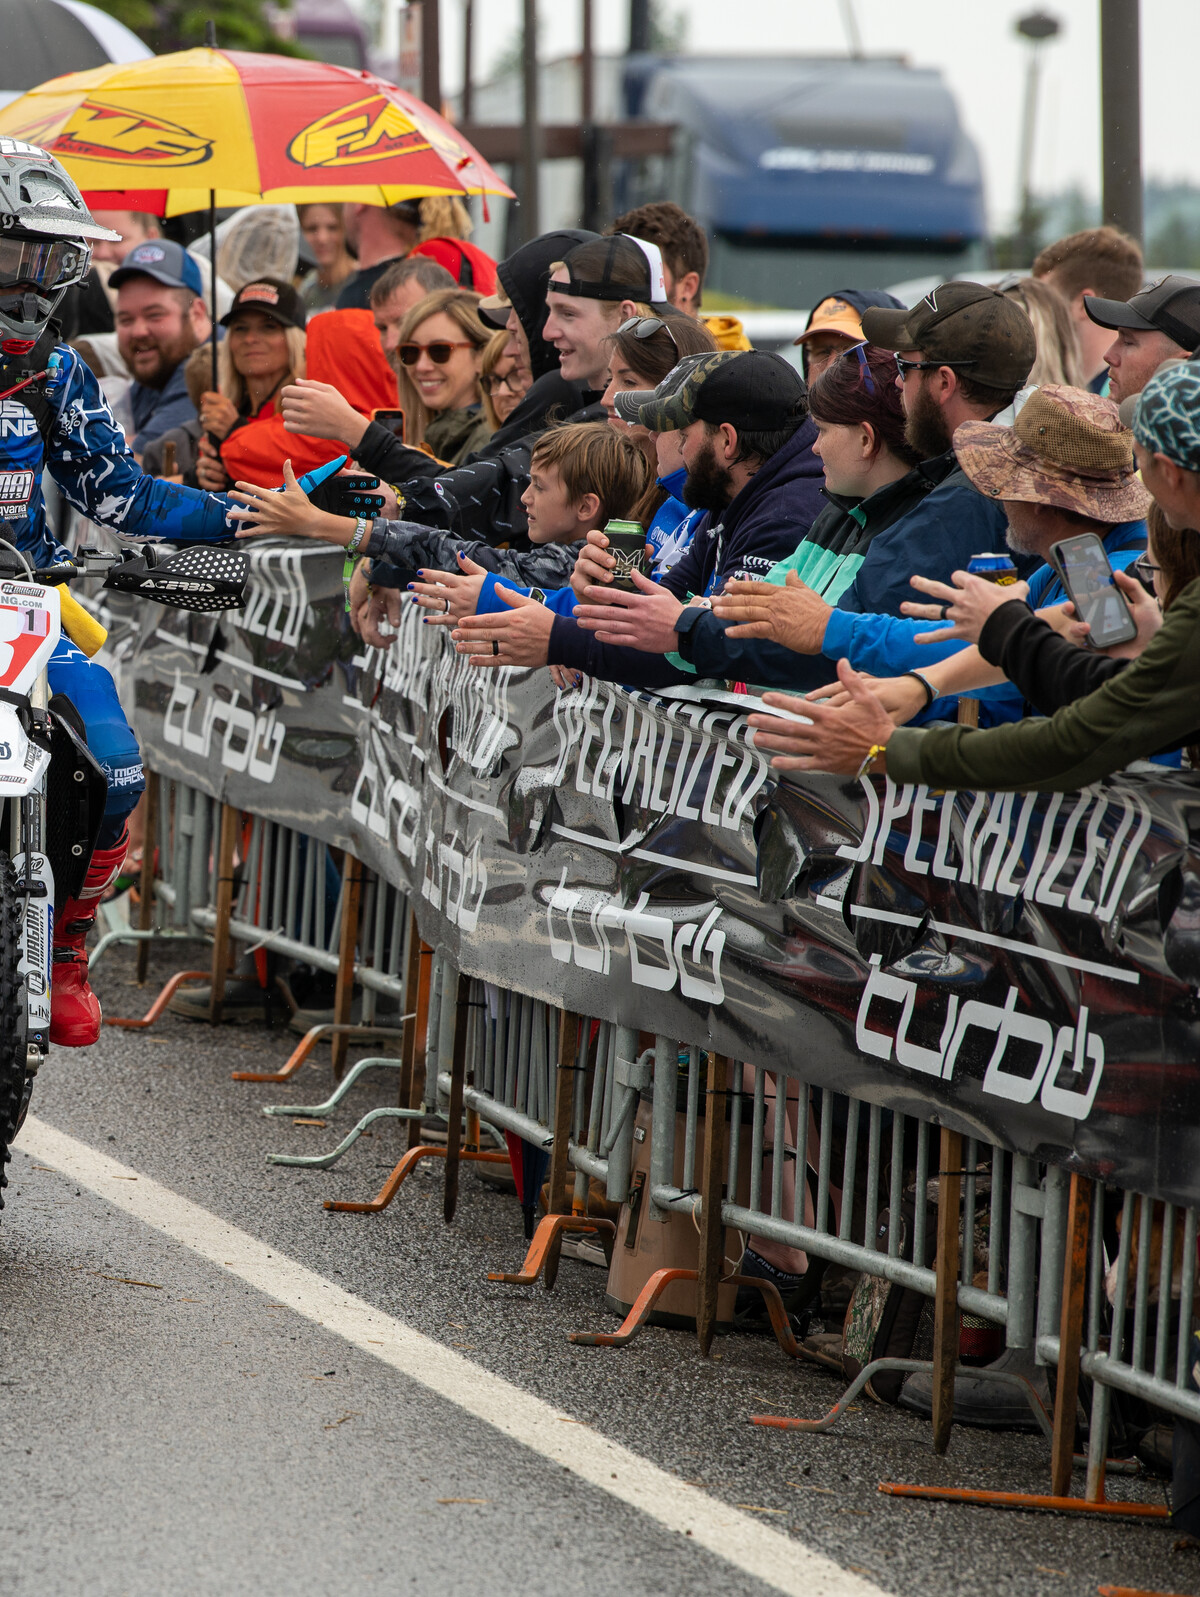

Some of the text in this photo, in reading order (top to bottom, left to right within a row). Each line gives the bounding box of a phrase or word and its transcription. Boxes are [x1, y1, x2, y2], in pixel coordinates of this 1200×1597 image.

[140, 578, 216, 593] ACERBIS
[25, 609, 35, 632] 1
[835, 773, 1152, 923] SPECIALIZED
